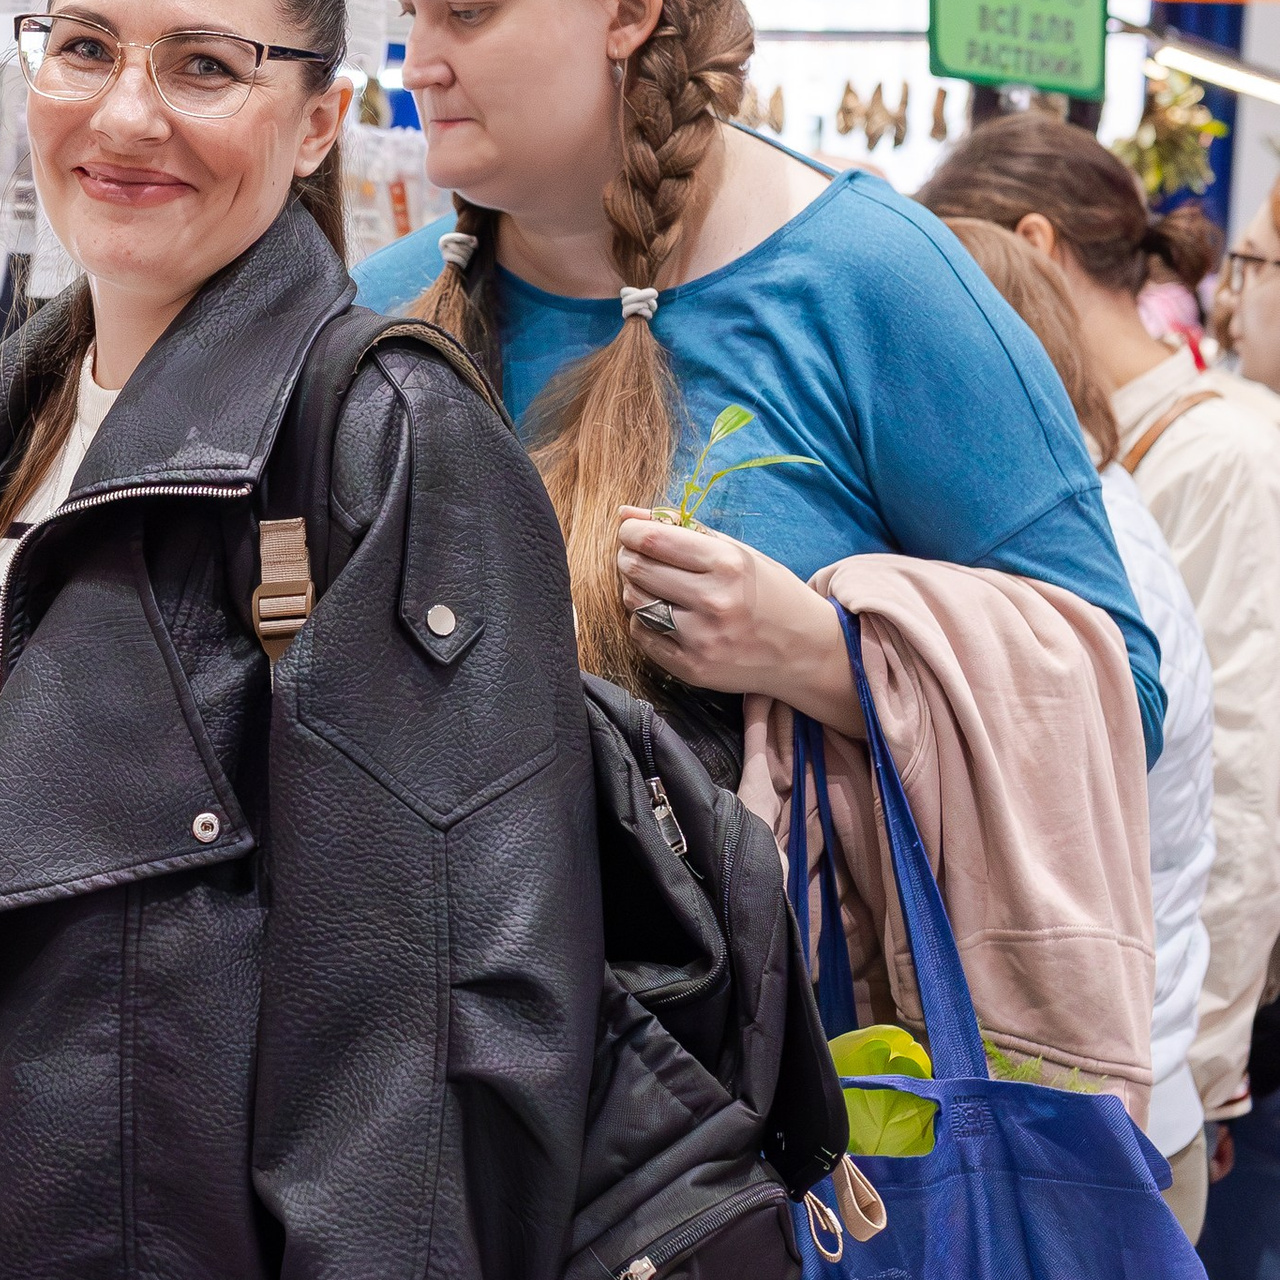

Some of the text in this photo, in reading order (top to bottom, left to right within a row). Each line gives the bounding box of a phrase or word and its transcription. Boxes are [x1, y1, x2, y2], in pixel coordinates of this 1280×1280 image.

[977, 3, 1077, 44] ВСЁ ДЛЯ
[966, 38, 1085, 78] РАСТЕНИЙ
